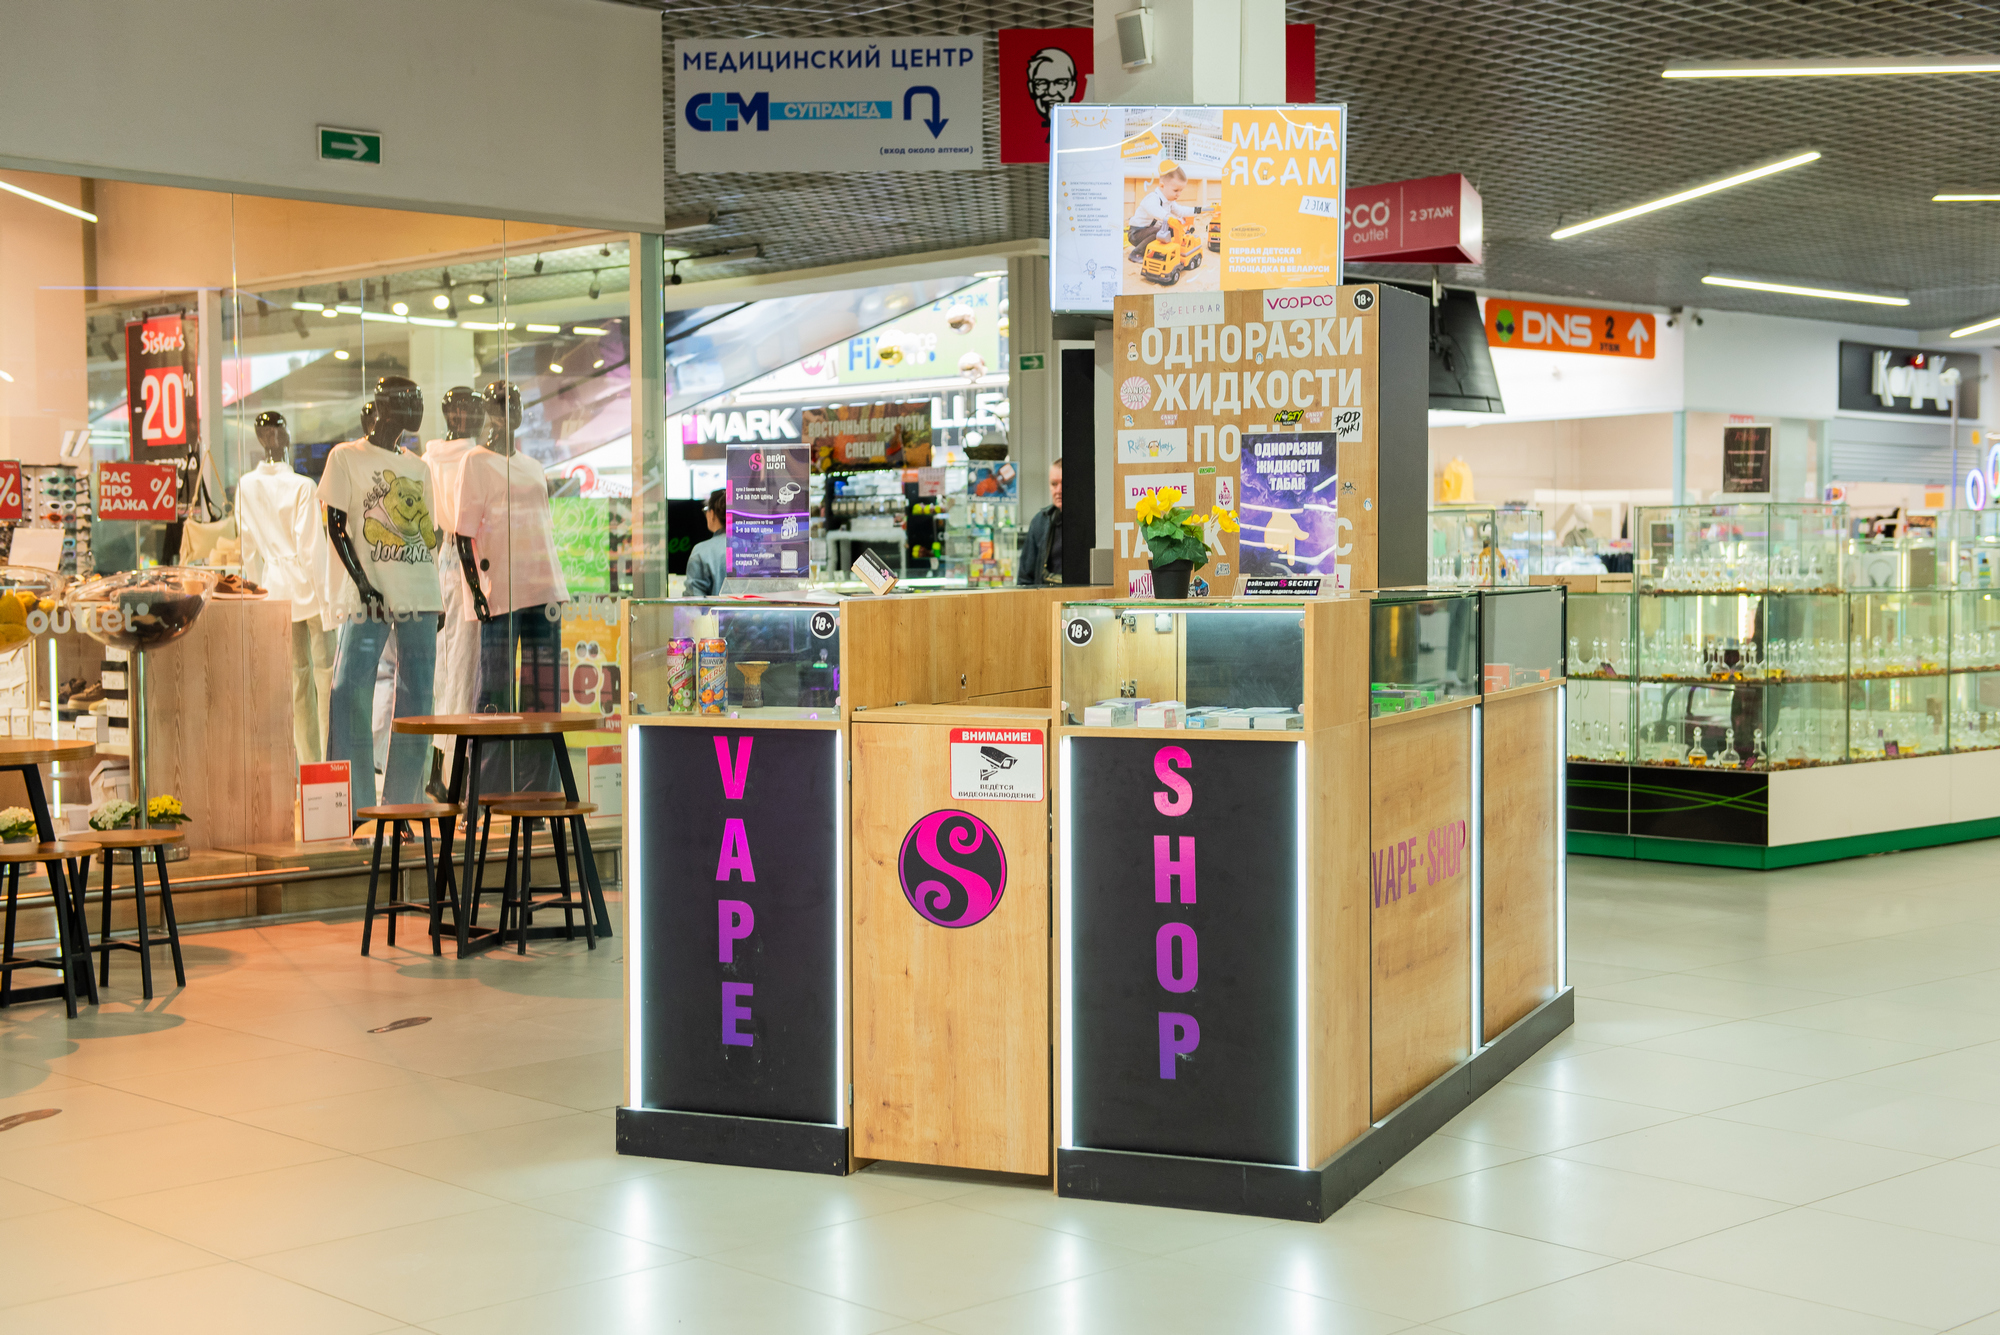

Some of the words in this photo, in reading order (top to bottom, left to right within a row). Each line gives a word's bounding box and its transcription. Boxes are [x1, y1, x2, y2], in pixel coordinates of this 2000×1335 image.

[683, 45, 881, 73] МЕДИЦИНСКИЙ
[891, 48, 973, 71] ЦЕНТР
[783, 102, 881, 119] СУПРАМЕД
[1231, 122, 1338, 151] МАМА
[908, 146, 935, 154] около
[1305, 198, 1310, 210] 2
[1311, 199, 1332, 213] ЭТАЖ
[1409, 210, 1417, 222] 2
[1419, 206, 1454, 221] ЭТАЖ
[1352, 227, 1390, 244] outlet
[1228, 256, 1295, 264] СТРОИТЕЛЬНАЯ
[1229, 247, 1261, 255] ПЕРВАЯ
[1262, 247, 1302, 256] ДЕТСКАЯ
[1228, 265, 1279, 274] ПЛОЩАДКА
[1280, 265, 1286, 273] В
[1286, 265, 1330, 273] БЕЛАРУСИ
[1266, 294, 1334, 311] VOOPOO
[1355, 293, 1372, 306] 18+
[1521, 310, 1593, 348] DNS
[1604, 315, 1615, 339] 2
[140, 326, 185, 355] Sister's
[1141, 316, 1363, 370] ОДНОРАЗКИ
[1152, 367, 1362, 416] ЖИДКОСТИ
[1274, 410, 1304, 422] NSTY
[808, 418, 869, 438] ВОСТОЧНЫЕ
[766, 454, 786, 462] ВЕЙП
[845, 441, 885, 459] СПЕЦИИ
[1254, 441, 1323, 459] ОДНОРАЗКИ
[766, 462, 786, 470] ШОП
[1256, 458, 1320, 476] ЖИДКОСТИ
[100, 471, 131, 484] РАС
[1269, 477, 1306, 491] ТАБАК
[100, 485, 133, 498] ПРО
[100, 498, 149, 512] ДАЖА
[371, 539, 434, 565] JOURNE
[26, 602, 138, 634] outlet
[331, 595, 424, 625] outlet
[814, 616, 833, 632] 18+
[1070, 622, 1090, 641] 18+
[961, 730, 1032, 742] ВНИМАНИЕ!
[958, 791, 1037, 799] ВИДЕОНАБЛЮДЕНИЕ
[980, 783, 1014, 791] ВЕДЁТСЯ
[1371, 836, 1417, 909] VAPE
[1427, 819, 1466, 887] SHOP
[712, 735, 757, 1047] VAPE
[1153, 745, 1201, 1080] SHOP
